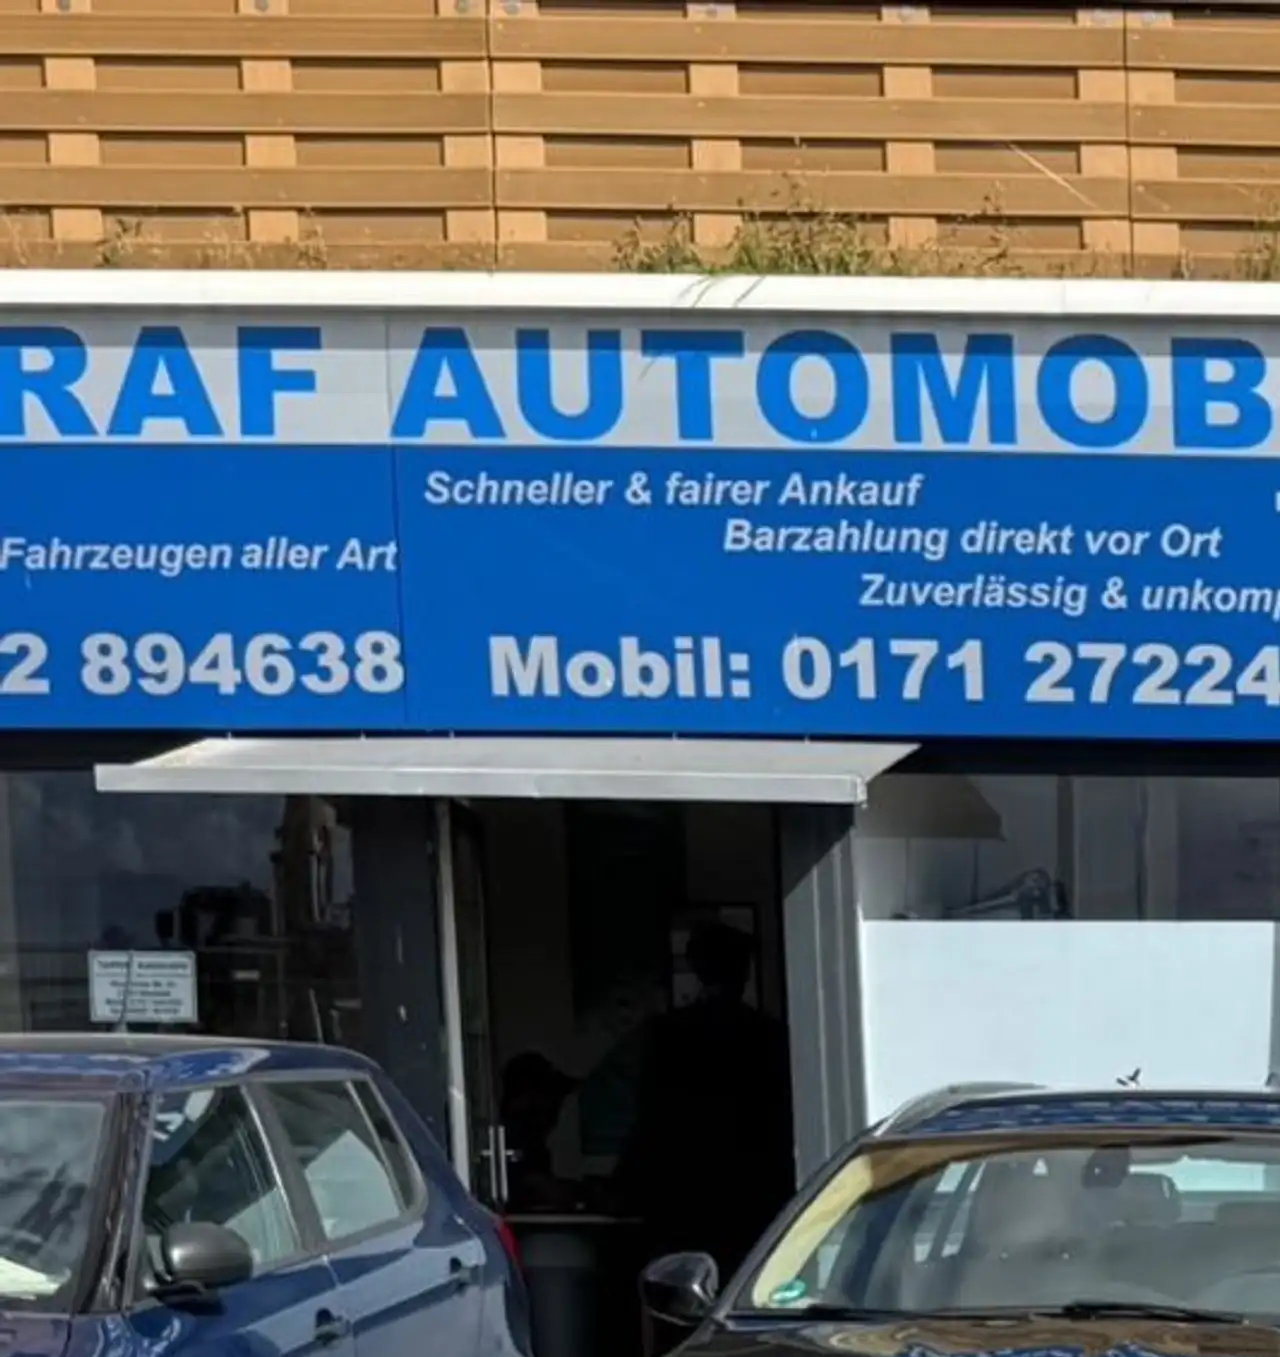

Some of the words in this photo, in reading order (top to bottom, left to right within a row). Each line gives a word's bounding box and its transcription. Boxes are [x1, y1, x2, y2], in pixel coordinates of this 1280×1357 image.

[0, 326, 321, 436] RAF
[425, 471, 613, 504] Schneller
[625, 472, 651, 504] &
[666, 472, 770, 505] fairer
[779, 473, 923, 506] Ankauf
[0, 538, 232, 577] Fahrzeugen
[241, 537, 328, 569] aller
[336, 538, 397, 570] Art
[724, 519, 948, 561] Barzahlung
[961, 521, 1074, 555] direkt
[1086, 531, 1149, 555] vor
[1161, 524, 1222, 557] Ort
[860, 574, 1087, 616] Zuverlässig
[1102, 576, 1128, 609] &
[0, 633, 50, 694] 2
[81, 631, 404, 695] 894638
[490, 636, 750, 698] Mobil:
[782, 637, 983, 701] 0171
